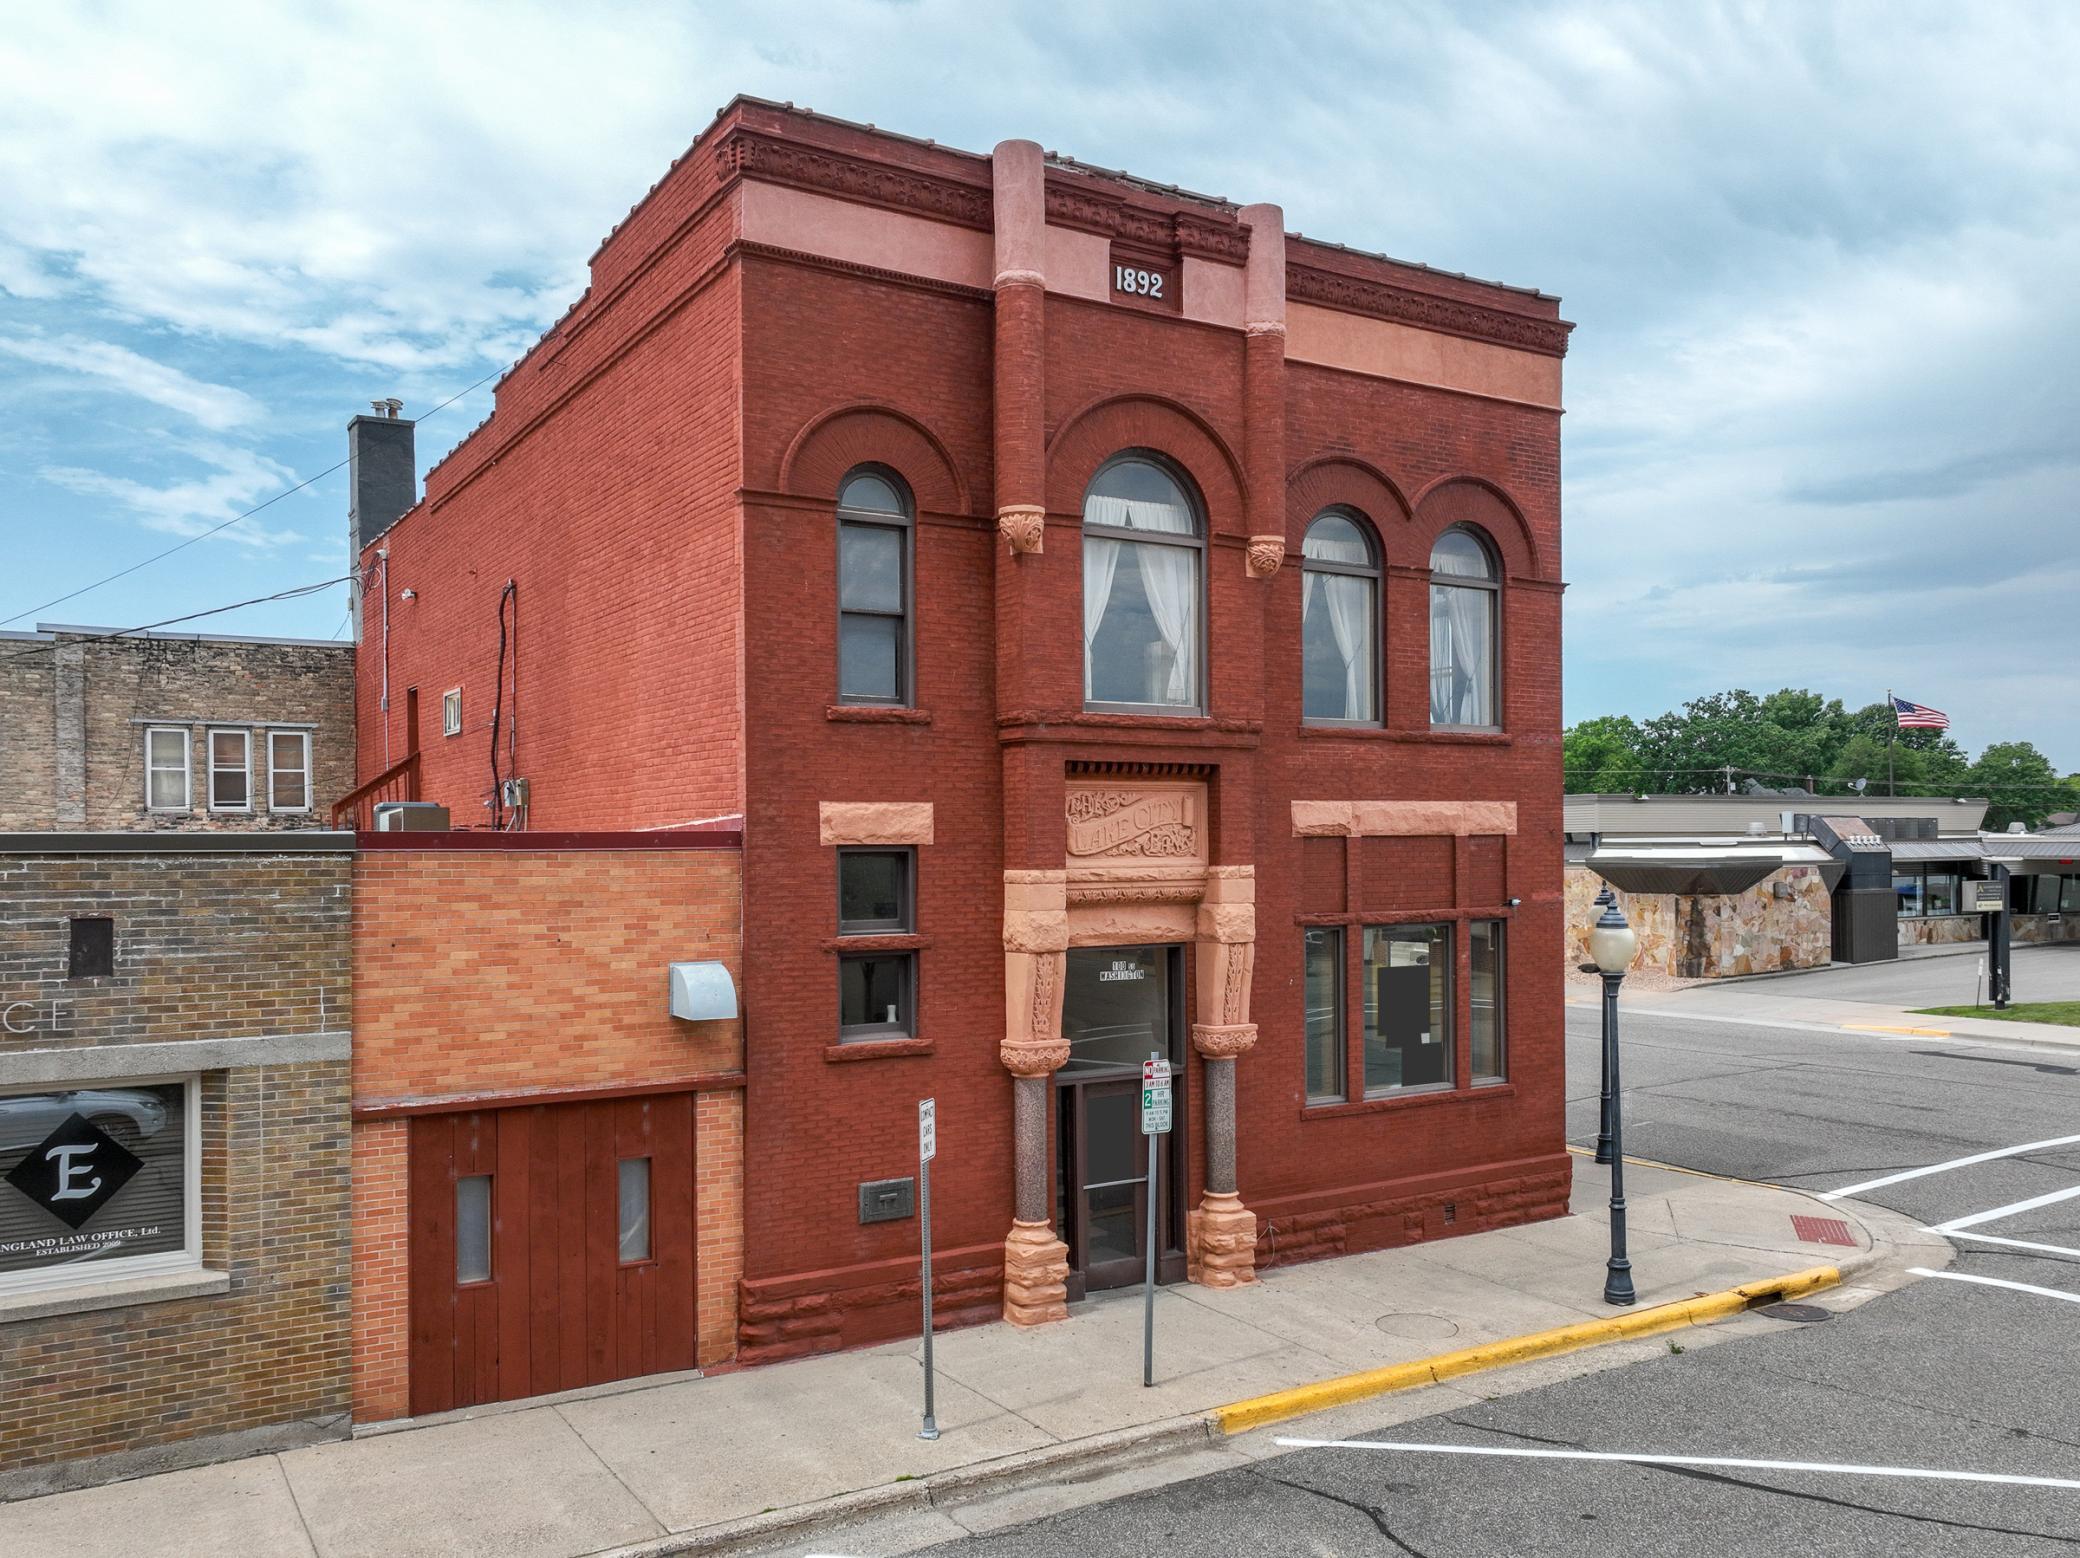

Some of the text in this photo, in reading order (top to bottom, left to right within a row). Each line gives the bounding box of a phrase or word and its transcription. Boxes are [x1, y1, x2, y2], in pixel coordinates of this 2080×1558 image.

[1116, 266, 1163, 298] 1892
[1133, 799, 1180, 830] CITY
[1145, 1093, 1151, 1106] 2
[923, 1123, 933, 1138] CARS
[45, 1142, 102, 1202] E
[0, 1226, 161, 1253] NGLAND LAW OFFICE, Ltd.
[36, 1242, 100, 1256] ESTABLISHED
